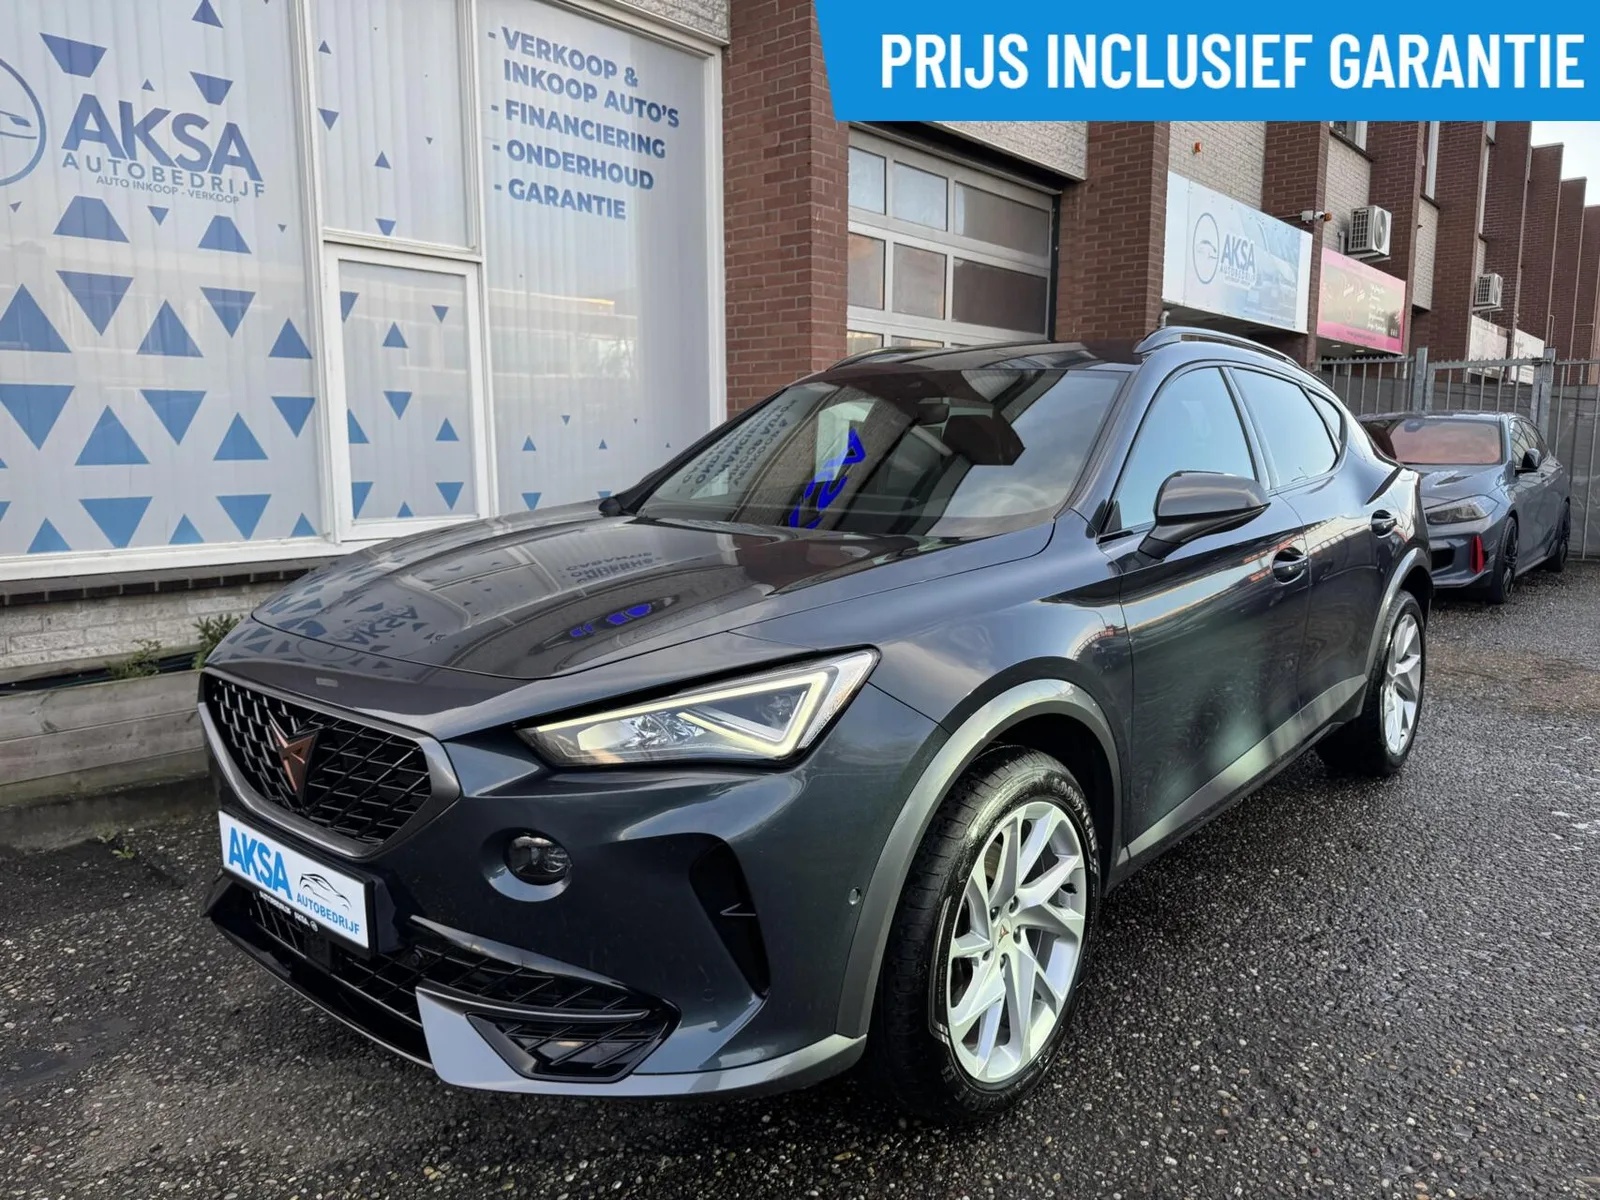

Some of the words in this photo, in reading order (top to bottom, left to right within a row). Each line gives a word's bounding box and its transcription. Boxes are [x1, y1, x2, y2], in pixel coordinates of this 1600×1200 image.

[501, 26, 617, 79] VERKOOP
[624, 67, 638, 87] &
[504, 59, 597, 103] INKOOP
[604, 90, 679, 128] AUTO'S
[61, 93, 263, 181] AKSA
[505, 99, 665, 159] FINANCIERING
[62, 152, 265, 198] AUTOBEDRIJF
[96, 175, 129, 188] AUTO
[132, 180, 178, 196] INKOOP
[187, 189, 239, 205] VERKOOP
[507, 139, 653, 190] ONDERHOUD
[508, 178, 626, 220] GARANTIE
[1221, 234, 1255, 274] AKSA
[229, 826, 293, 901] AKSA
[297, 892, 360, 935] AUTOBEDRIJF
